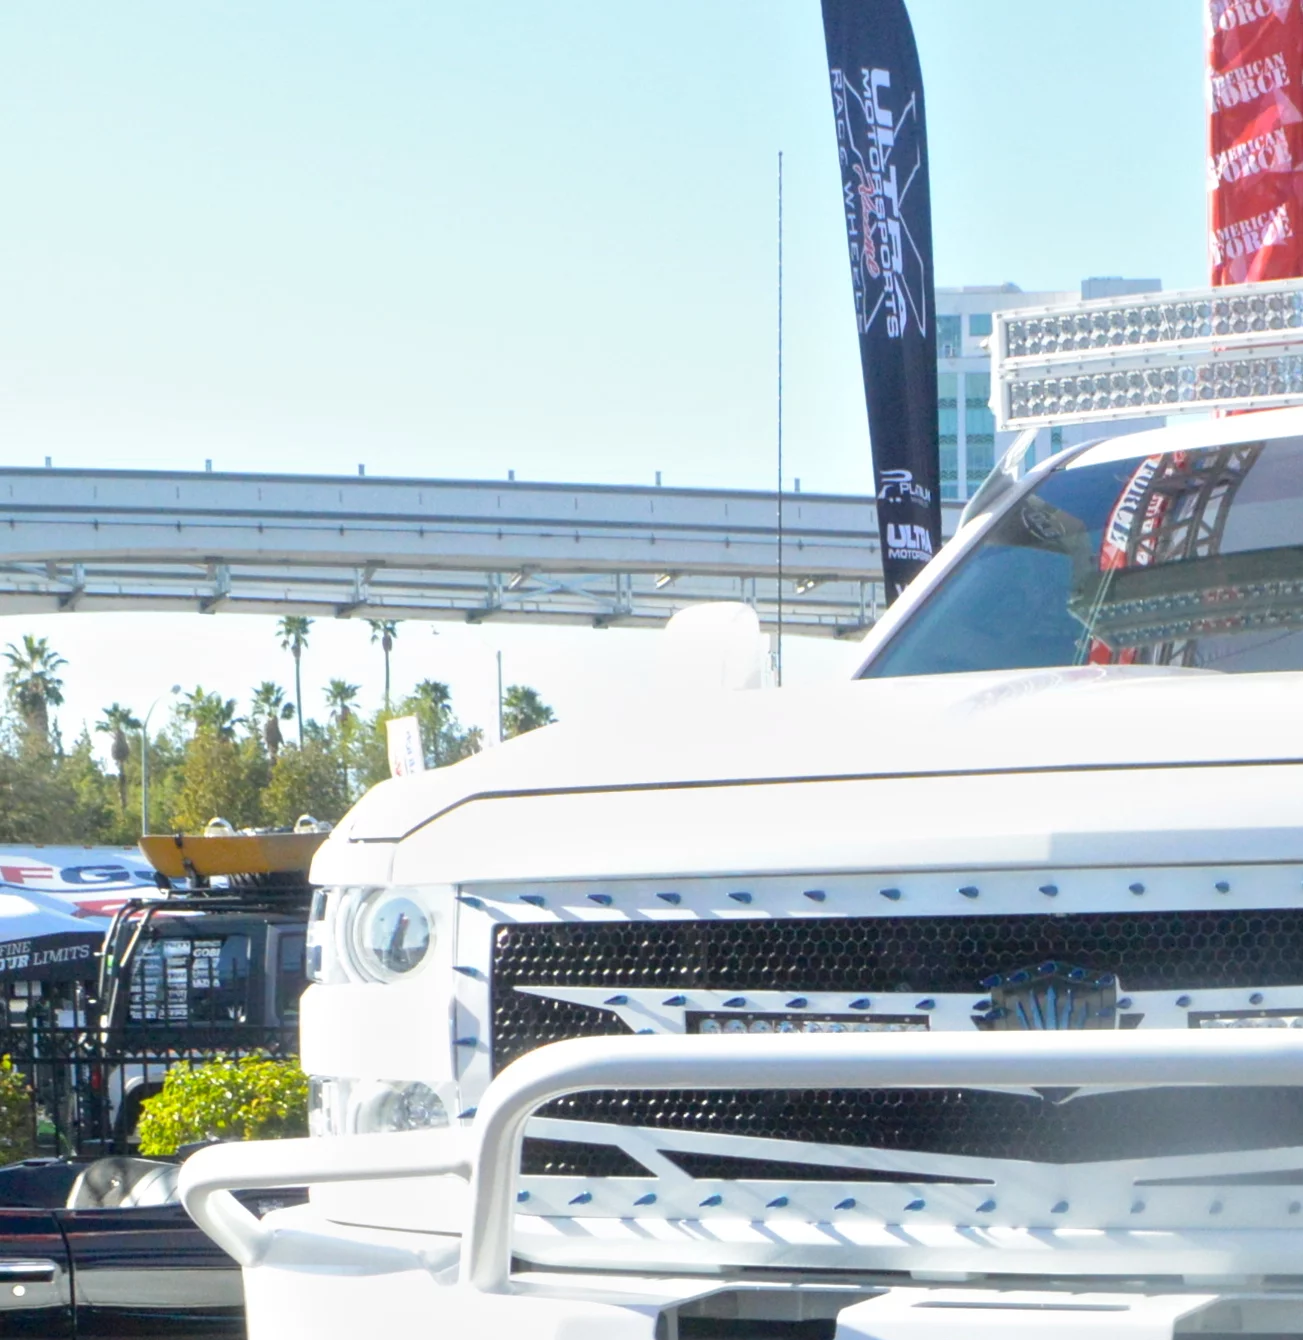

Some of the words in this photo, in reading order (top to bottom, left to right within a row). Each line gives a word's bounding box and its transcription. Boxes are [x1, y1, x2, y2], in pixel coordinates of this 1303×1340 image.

[1211, 67, 1291, 112] FORCE
[861, 67, 899, 338] MOTORSPORTS
[871, 68, 907, 339] ULTRA
[886, 522, 932, 554] ULTRA
[33, 945, 90, 966] LIMITS
